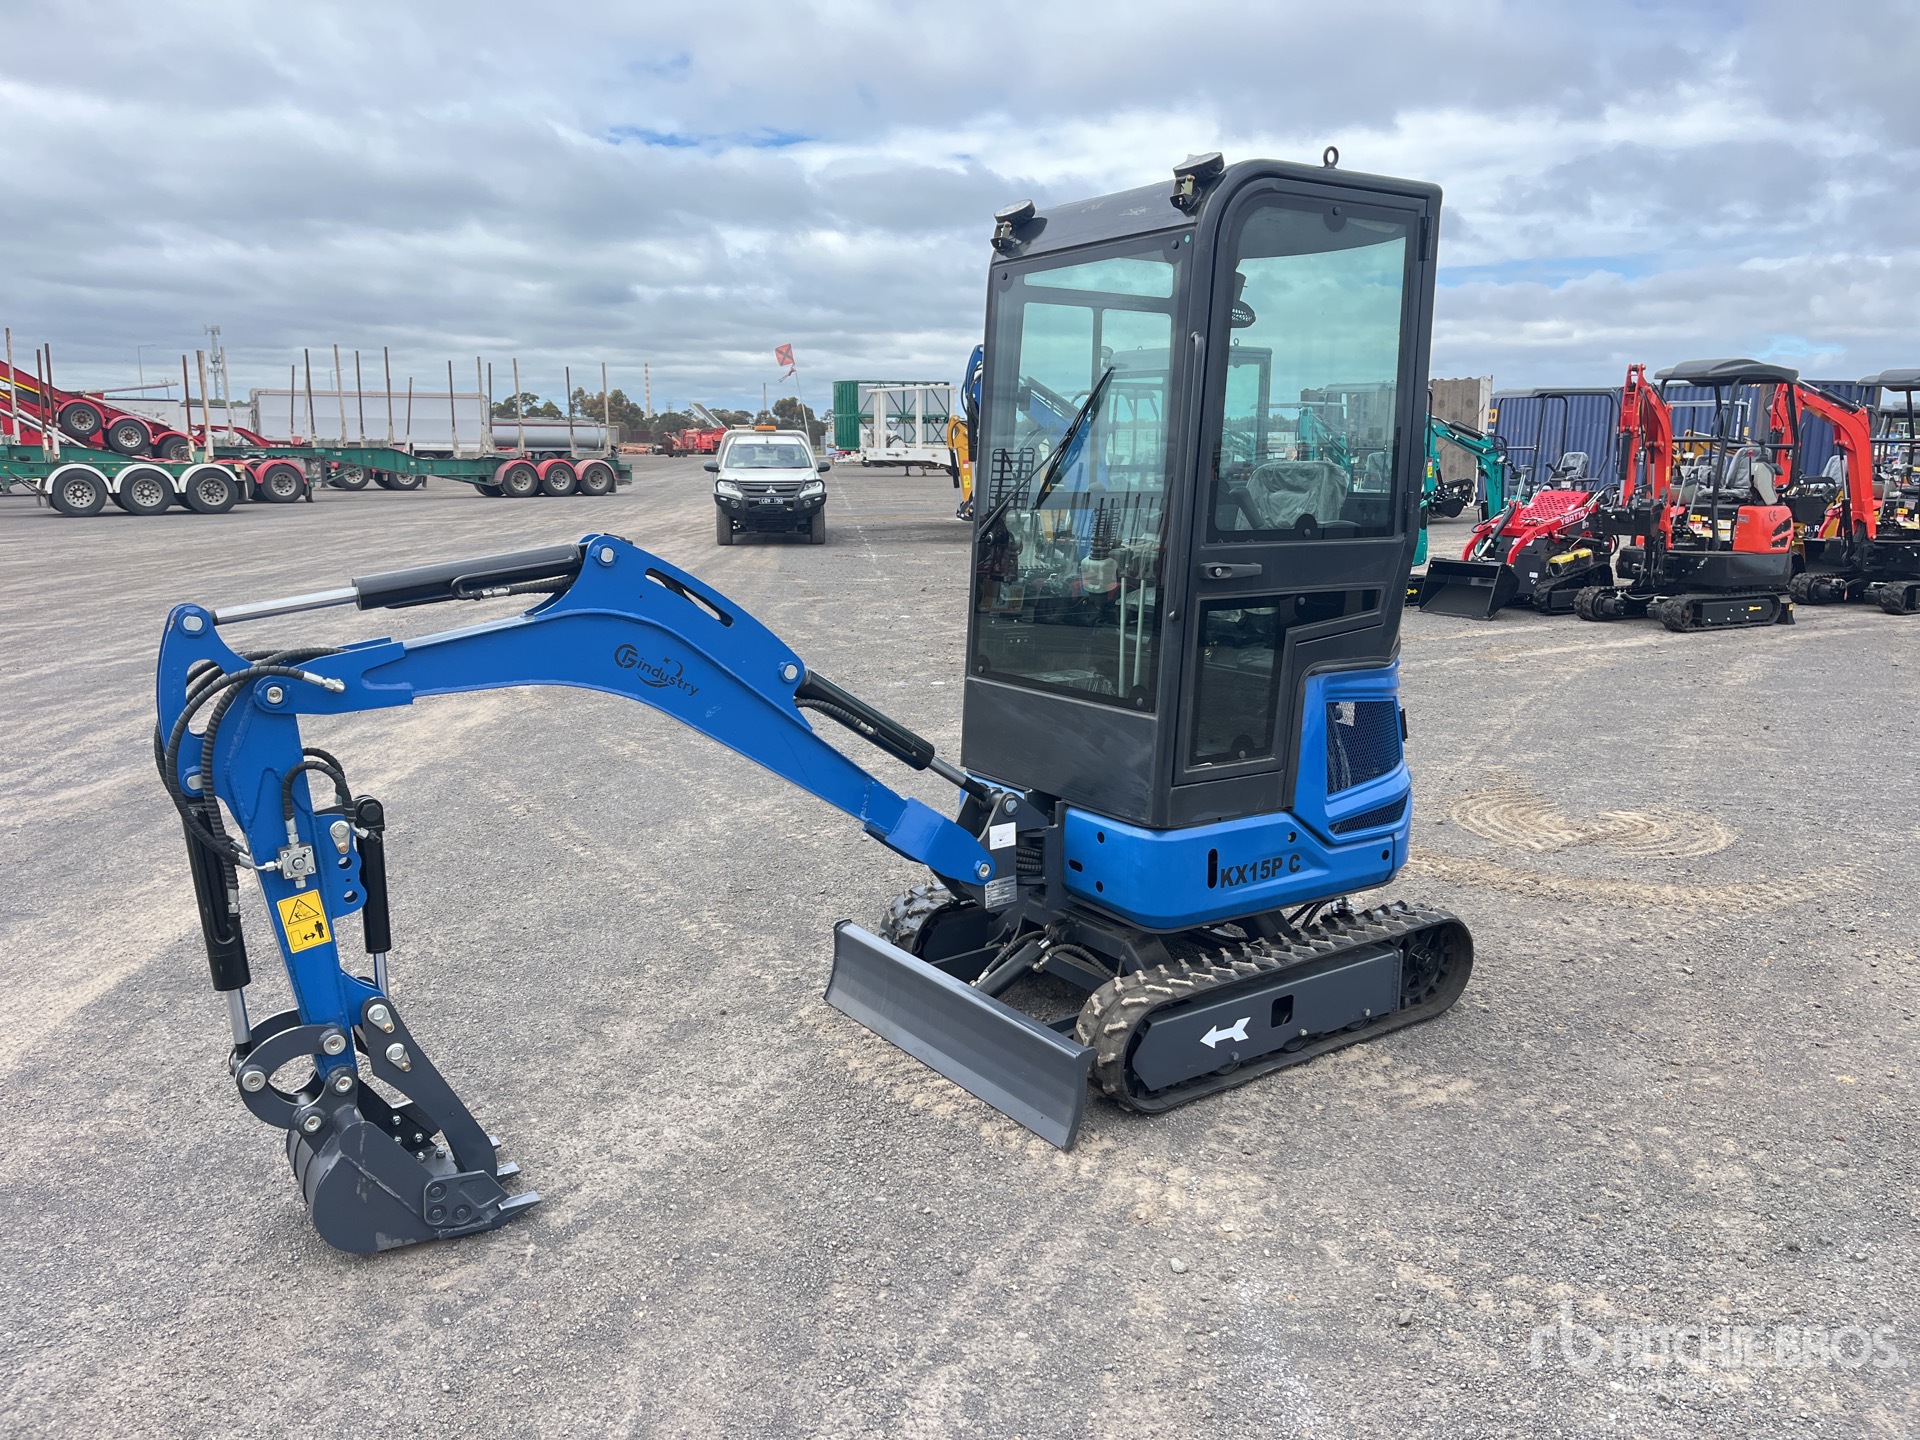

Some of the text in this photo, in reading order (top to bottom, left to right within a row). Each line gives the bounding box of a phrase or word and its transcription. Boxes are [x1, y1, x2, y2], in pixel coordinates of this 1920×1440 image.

[1560, 510, 1586, 526] YSRT14
[1220, 854, 1301, 889] KX15P C
